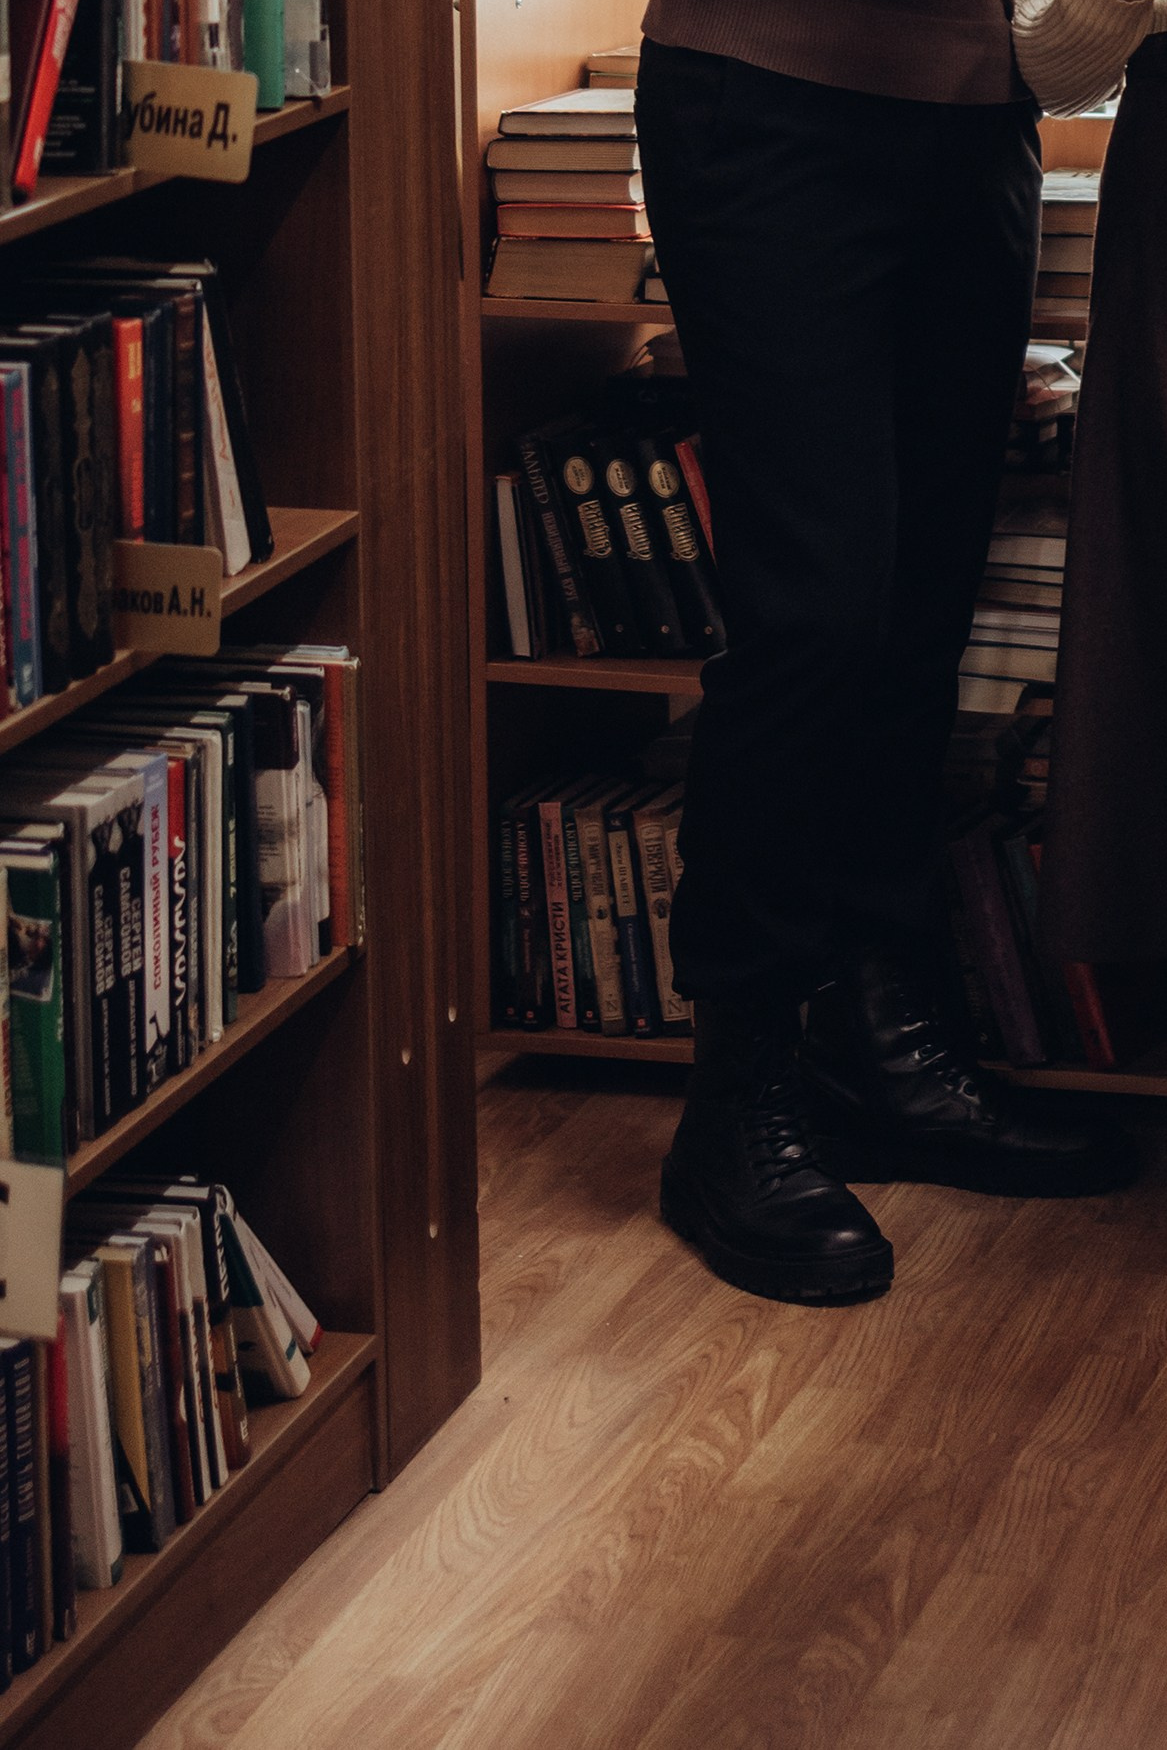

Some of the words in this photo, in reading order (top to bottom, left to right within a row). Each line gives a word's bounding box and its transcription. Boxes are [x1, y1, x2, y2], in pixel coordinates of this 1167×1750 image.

[207, 101, 238, 150] Д.
[167, 585, 212, 618] А.Н.
[151, 804, 161, 868] РУБЕЖ
[94, 884, 106, 997] САМСОНОВ
[104, 914, 116, 991] СЕРГЕЙ
[119, 866, 132, 978] САМСОНОВ
[131, 897, 143, 973] СЕРГЕЙ
[151, 870, 162, 991] СОКОЛИНЫЙ
[552, 901, 567, 961] КРИСТИ
[557, 966, 571, 1014] АГАТА
